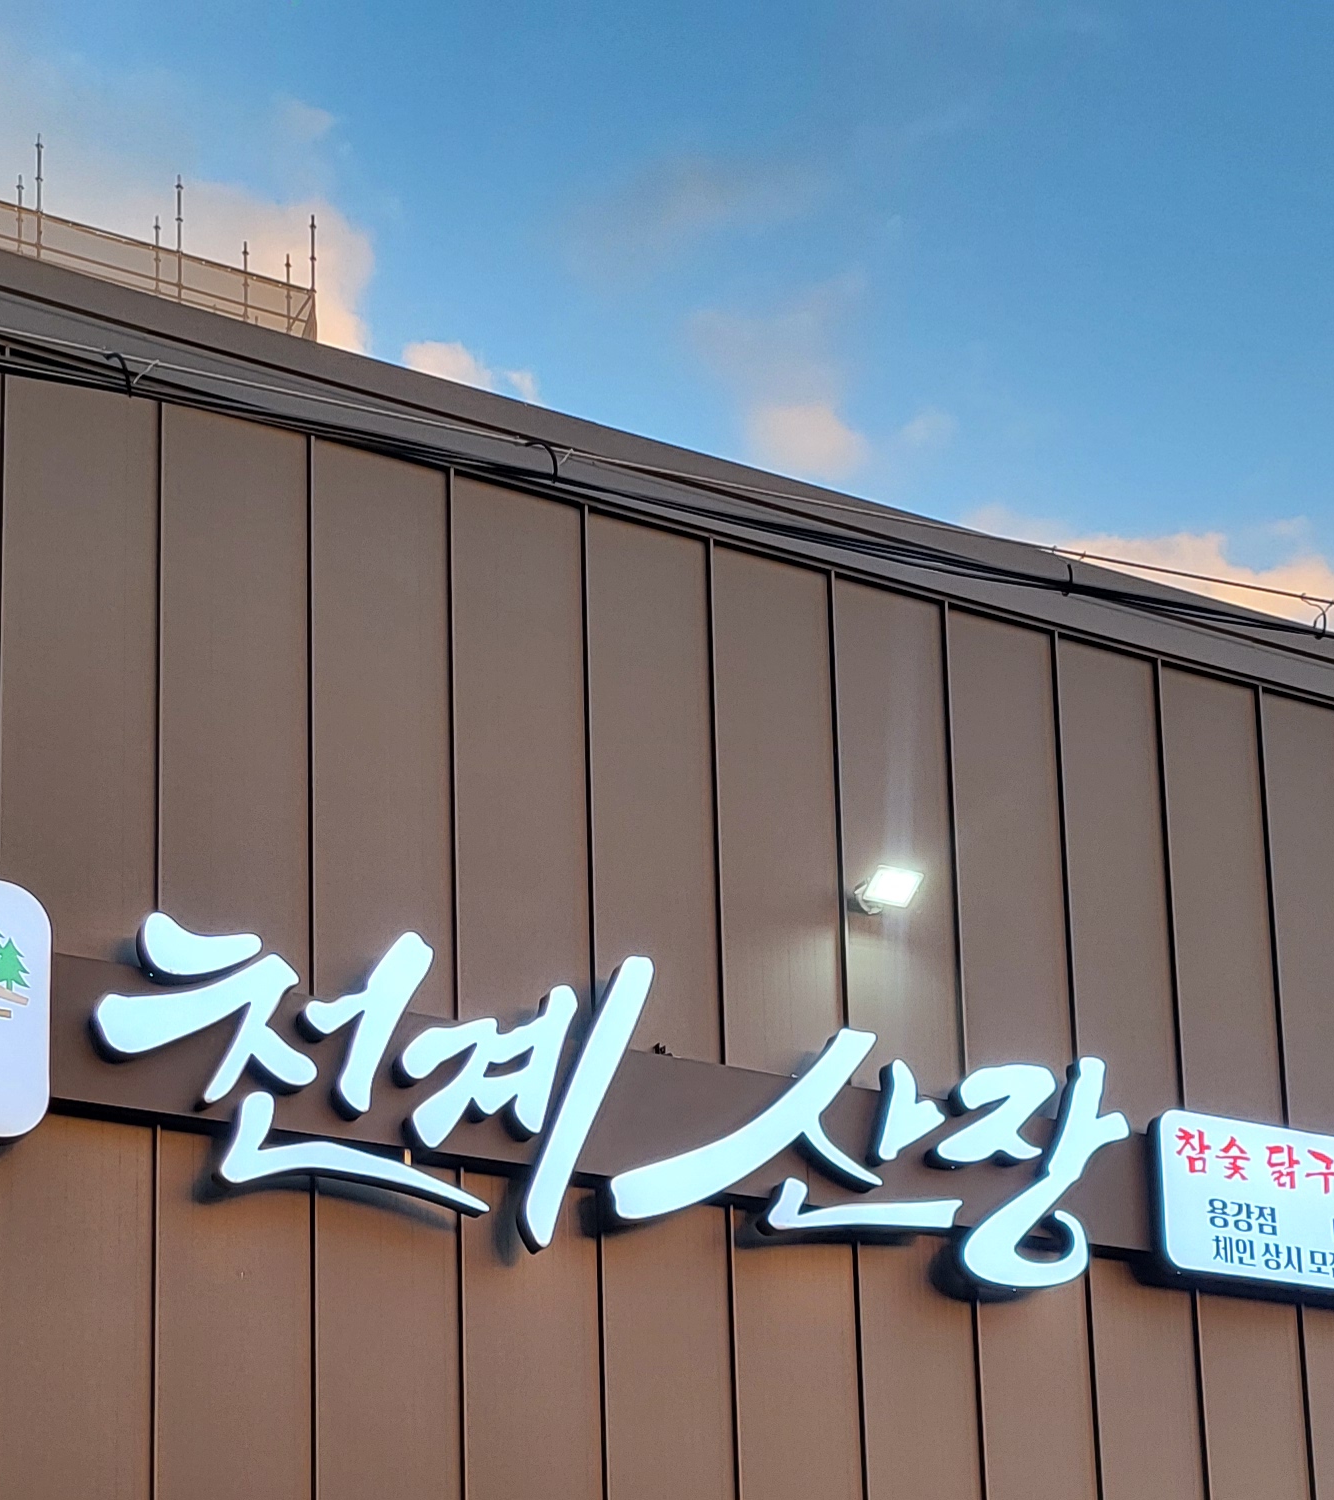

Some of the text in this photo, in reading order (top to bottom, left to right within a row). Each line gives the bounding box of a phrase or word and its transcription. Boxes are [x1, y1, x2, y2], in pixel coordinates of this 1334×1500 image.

[95, 912, 1130, 1288] 천계 산장
[1175, 1127, 1251, 1181] 참숯
[1206, 1198, 1278, 1236] 용강점
[1211, 1235, 1257, 1267] 체인
[1261, 1242, 1304, 1274] 상시
